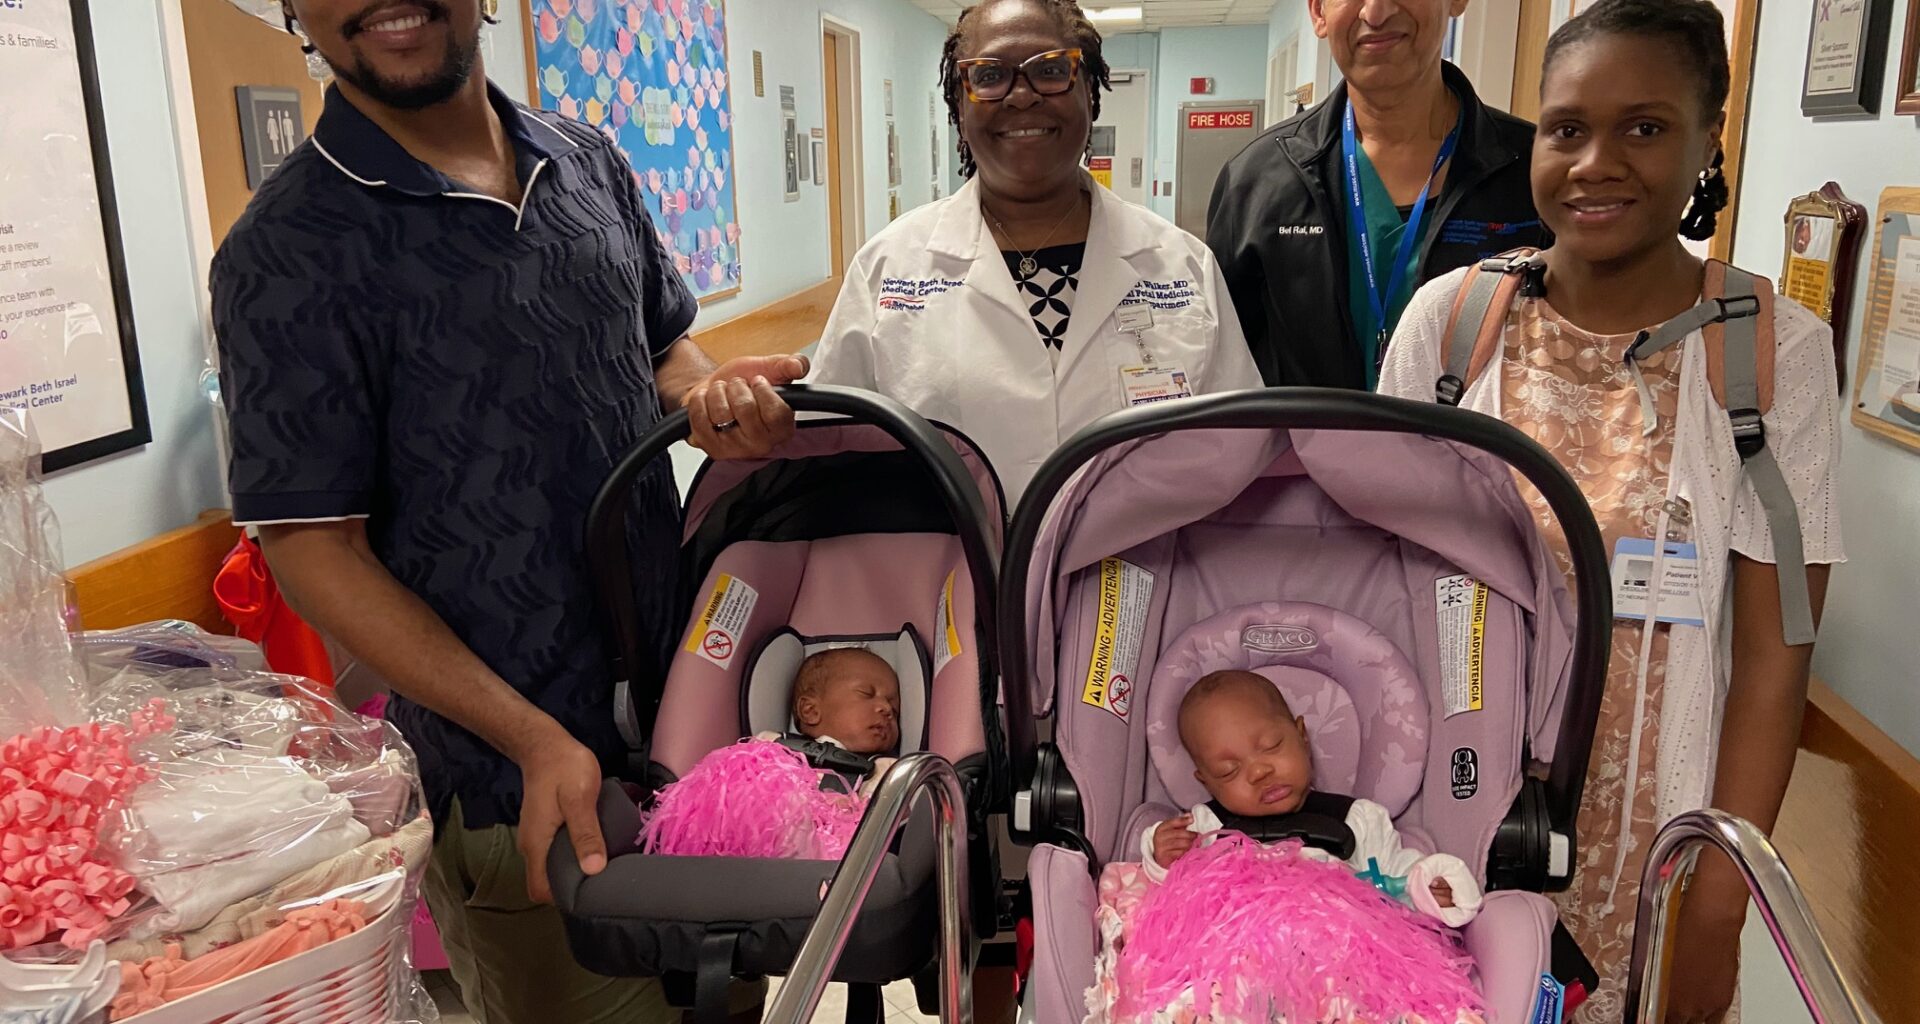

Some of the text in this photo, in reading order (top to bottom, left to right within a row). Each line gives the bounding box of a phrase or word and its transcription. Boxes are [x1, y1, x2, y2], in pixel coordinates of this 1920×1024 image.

[18, 34, 58, 49] families!
[1190, 113, 1251, 127] FIRE HOSE
[1309, 226, 1323, 234] MD
[15, 241, 40, 252] review
[883, 278, 916, 288] Newark
[918, 279, 939, 289] Beth
[1174, 280, 1189, 289] MD
[17, 290, 37, 301] team
[39, 287, 55, 297] with
[882, 287, 948, 296] Medical Center
[1135, 289, 1155, 299] Fetal
[1156, 289, 1195, 300] Medicine
[5, 311, 23, 323] your
[25, 303, 66, 318] experience
[30, 381, 53, 394] Beth
[54, 374, 77, 389] Israel
[31, 394, 63, 408] Center
[1665, 570, 1692, 579] Patient
[707, 591, 724, 622] WARNING
[1091, 559, 1118, 688] WARNING ADVERTENCIA
[1246, 629, 1313, 645] GRACO
[1471, 582, 1487, 703] WARNING ADVERTENCIA
